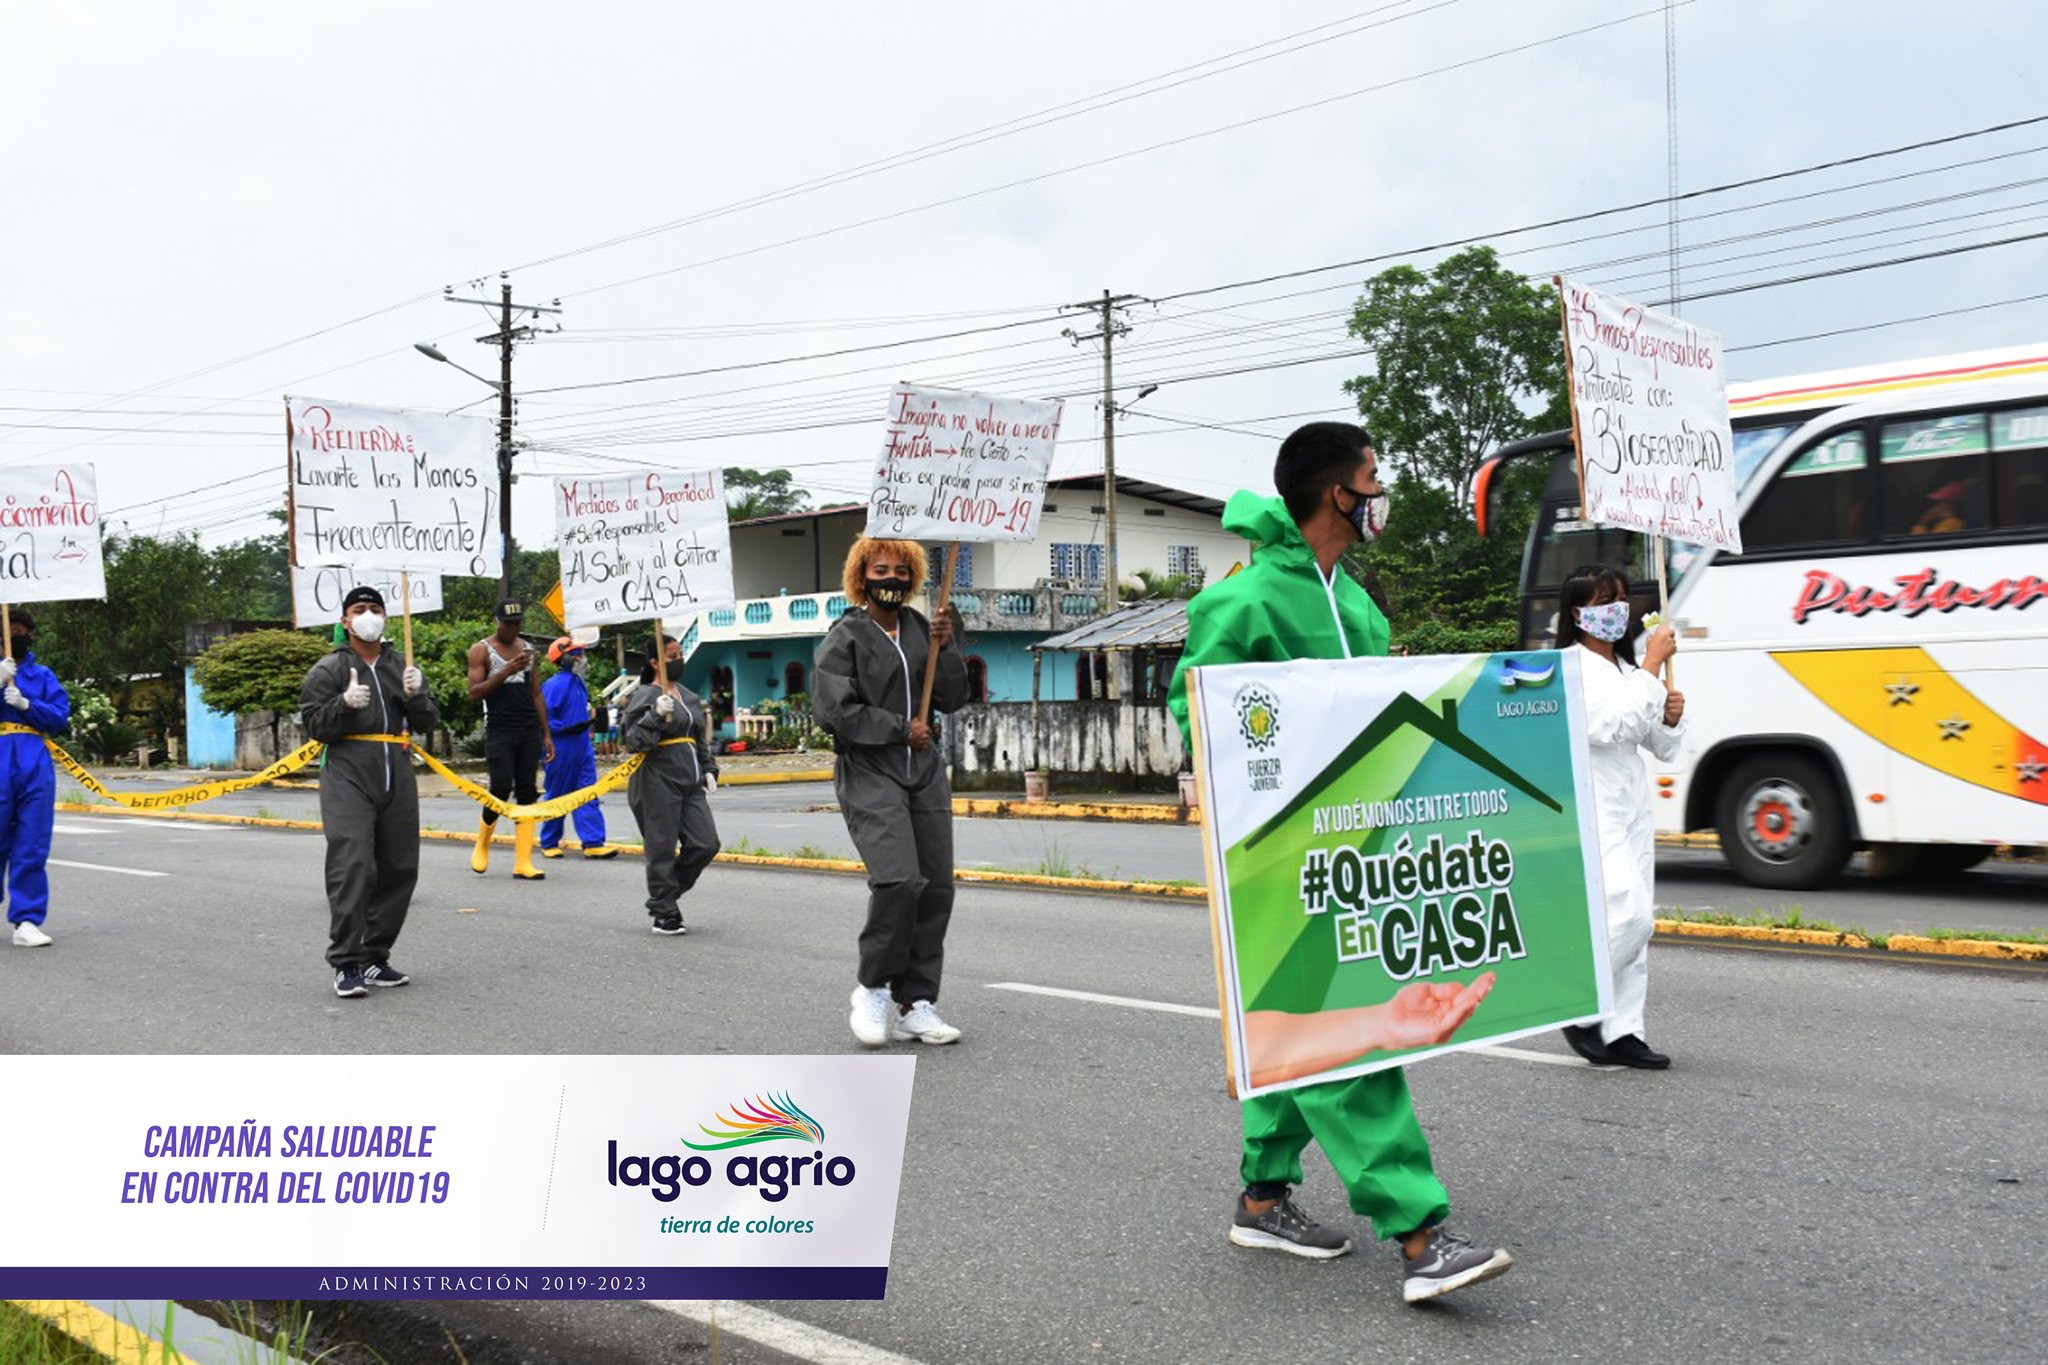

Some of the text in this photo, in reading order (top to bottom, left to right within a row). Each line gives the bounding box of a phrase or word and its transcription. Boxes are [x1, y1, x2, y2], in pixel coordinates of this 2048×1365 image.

[890, 391, 946, 439] Imagina
[952, 413, 966, 432] no
[296, 450, 478, 489] Lavarte las Manos
[948, 495, 1032, 534] COVID-19
[674, 530, 721, 567] Entrar
[594, 597, 611, 612] en
[1496, 699, 1559, 717] LAGO AGRIO
[1247, 758, 1282, 777] FUERZA
[1301, 830, 1514, 915] #Quédate
[1337, 892, 1524, 976] En CASA
